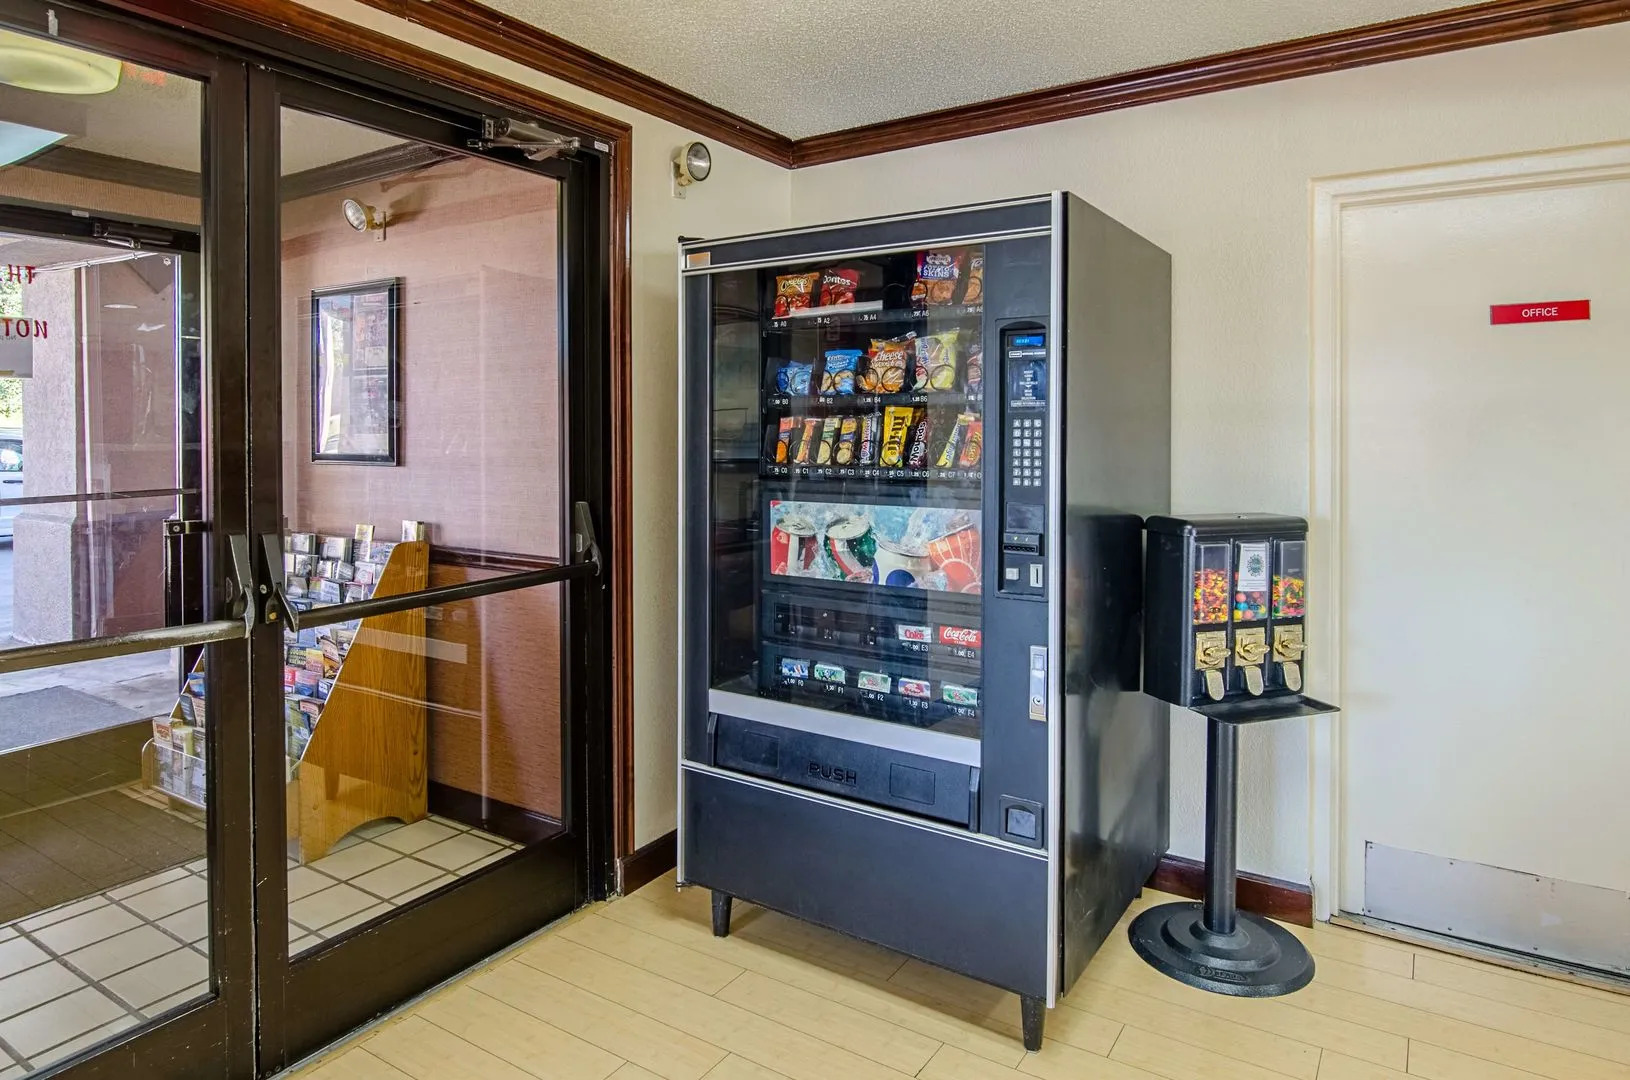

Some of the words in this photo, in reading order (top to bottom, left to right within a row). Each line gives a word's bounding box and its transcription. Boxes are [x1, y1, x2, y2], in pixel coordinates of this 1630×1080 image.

[923, 270, 950, 278] SKINS
[1521, 307, 1558, 318] OFFICE
[910, 421, 926, 462] Mounds
[808, 761, 857, 784] PUSH
